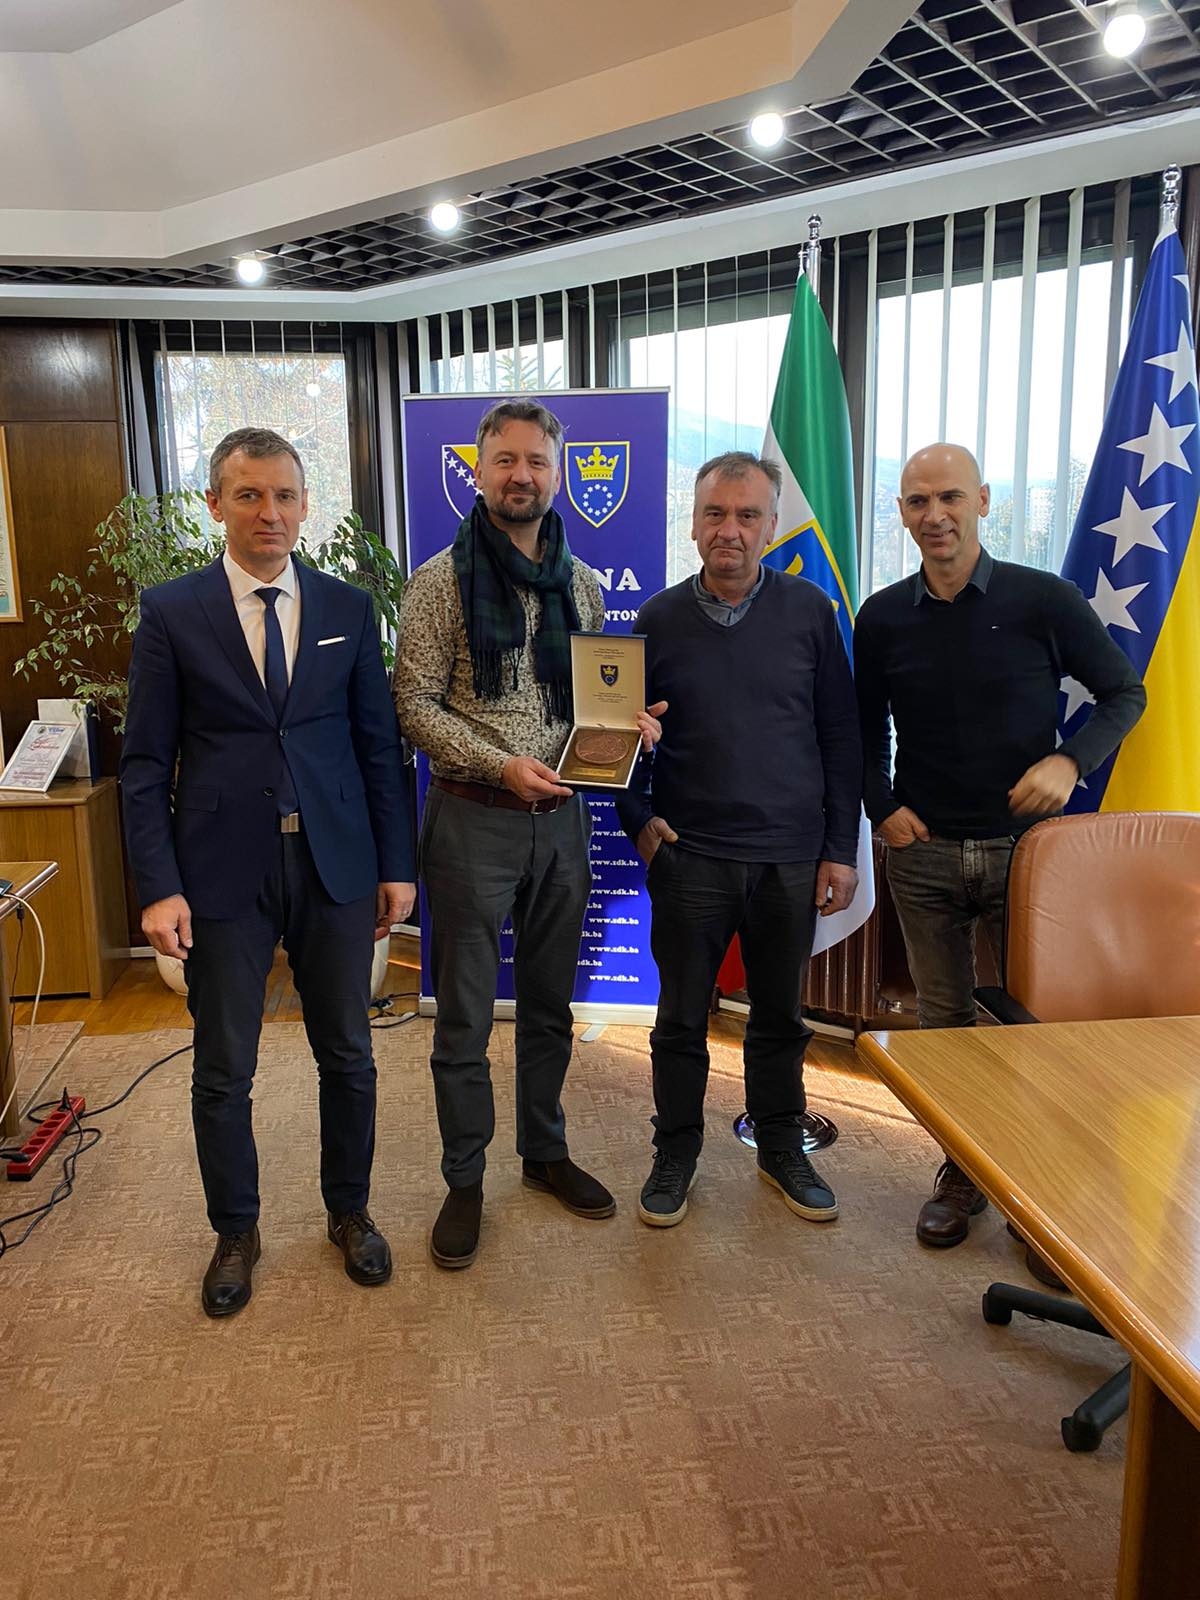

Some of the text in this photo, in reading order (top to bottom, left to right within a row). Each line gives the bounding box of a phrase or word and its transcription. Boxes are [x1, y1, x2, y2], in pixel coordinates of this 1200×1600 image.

[589, 917, 639, 925] www.zdk.ba
[589, 946, 639, 954] www.zdk.ba
[589, 974, 639, 983] www.zdk.ba
